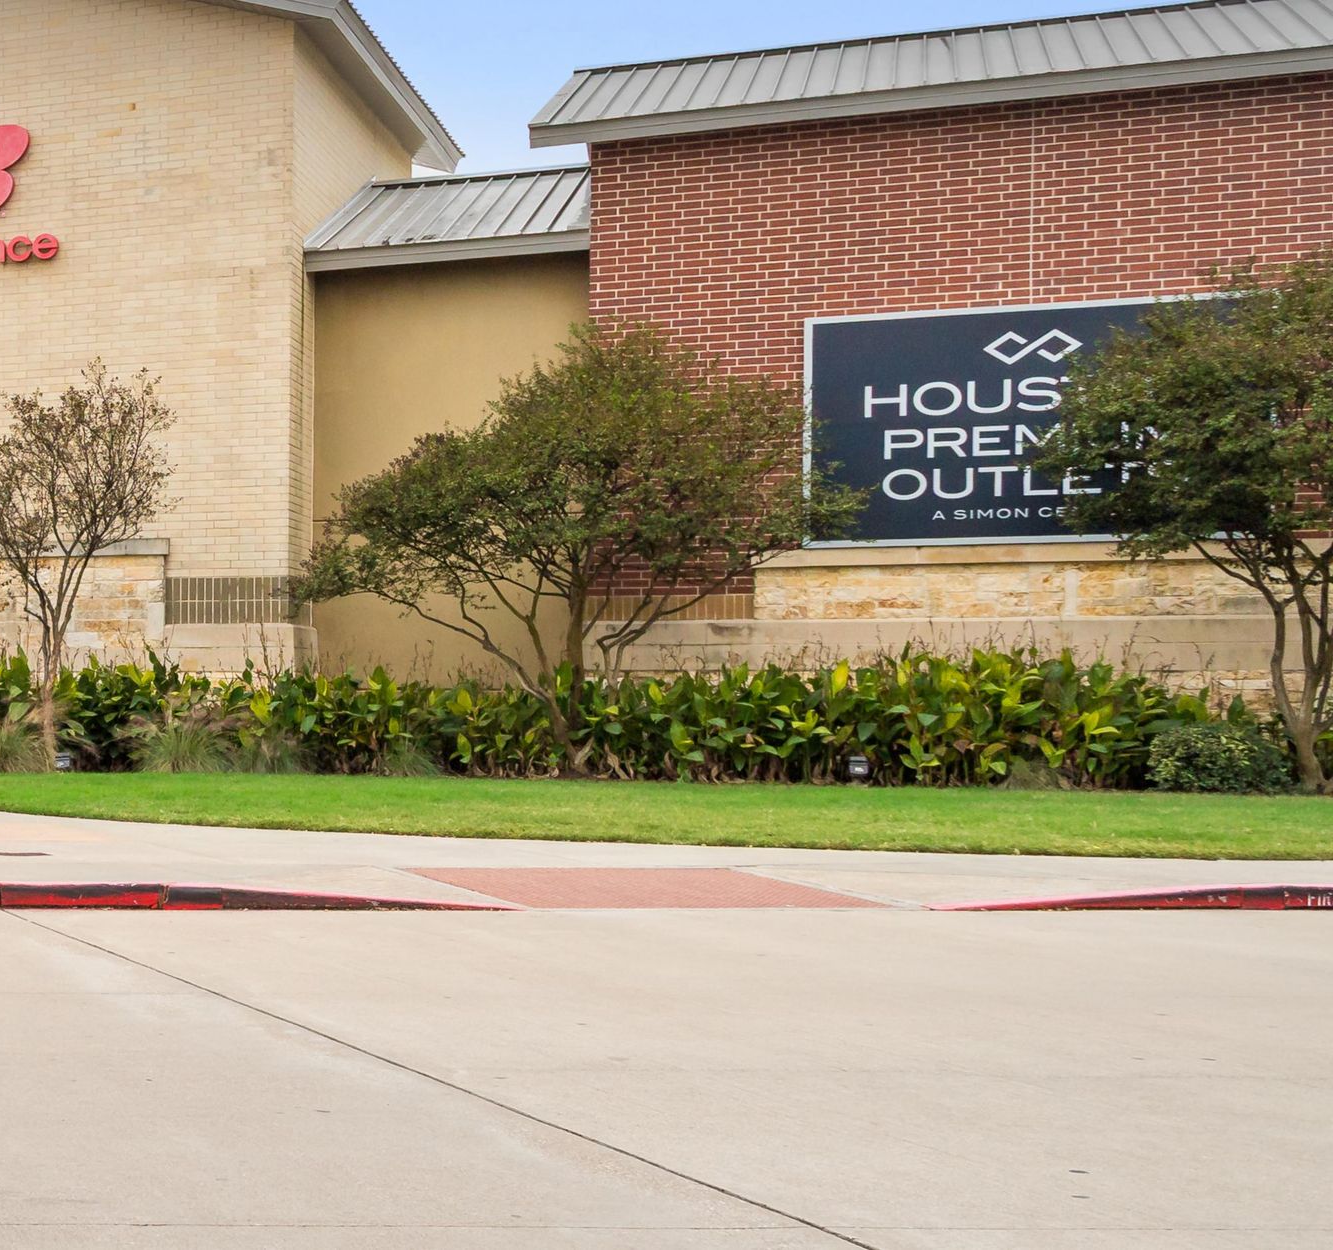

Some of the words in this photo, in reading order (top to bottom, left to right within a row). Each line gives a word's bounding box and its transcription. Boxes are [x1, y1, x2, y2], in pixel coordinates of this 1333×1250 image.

[864, 376, 1073, 418] HOUS
[932, 510, 946, 520] A
[953, 507, 1030, 520] SIMON
